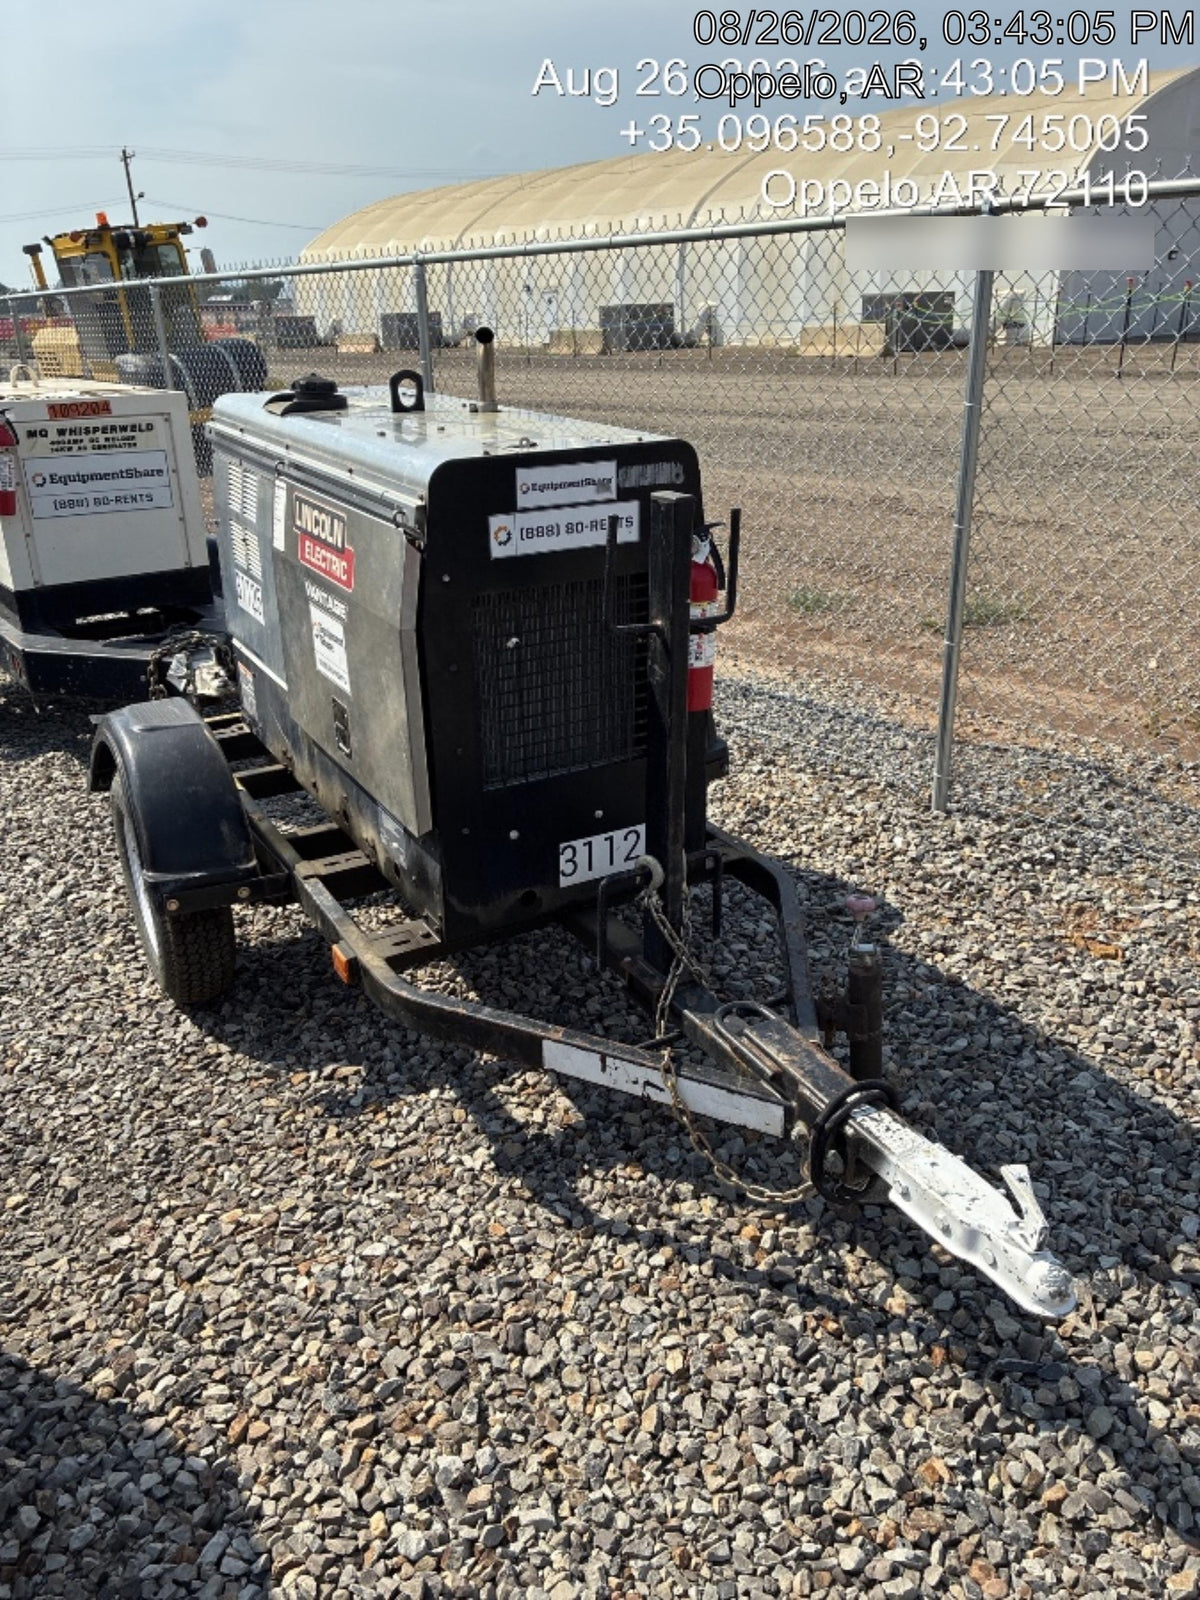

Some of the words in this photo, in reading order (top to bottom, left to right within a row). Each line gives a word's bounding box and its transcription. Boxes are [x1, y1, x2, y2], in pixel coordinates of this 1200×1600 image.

[48, 401, 111, 418] 109204
[26, 428, 48, 438] MQ
[56, 422, 153, 437] WHISPERWELD
[49, 468, 164, 486] EquipmentShare
[53, 498, 89, 511] (888)
[295, 501, 343, 549] LINCOLN
[520, 523, 560, 541] (888)
[565, 516, 634, 534] 80-RETS
[305, 540, 347, 581] ELECTRIC
[560, 829, 641, 877] 3112
